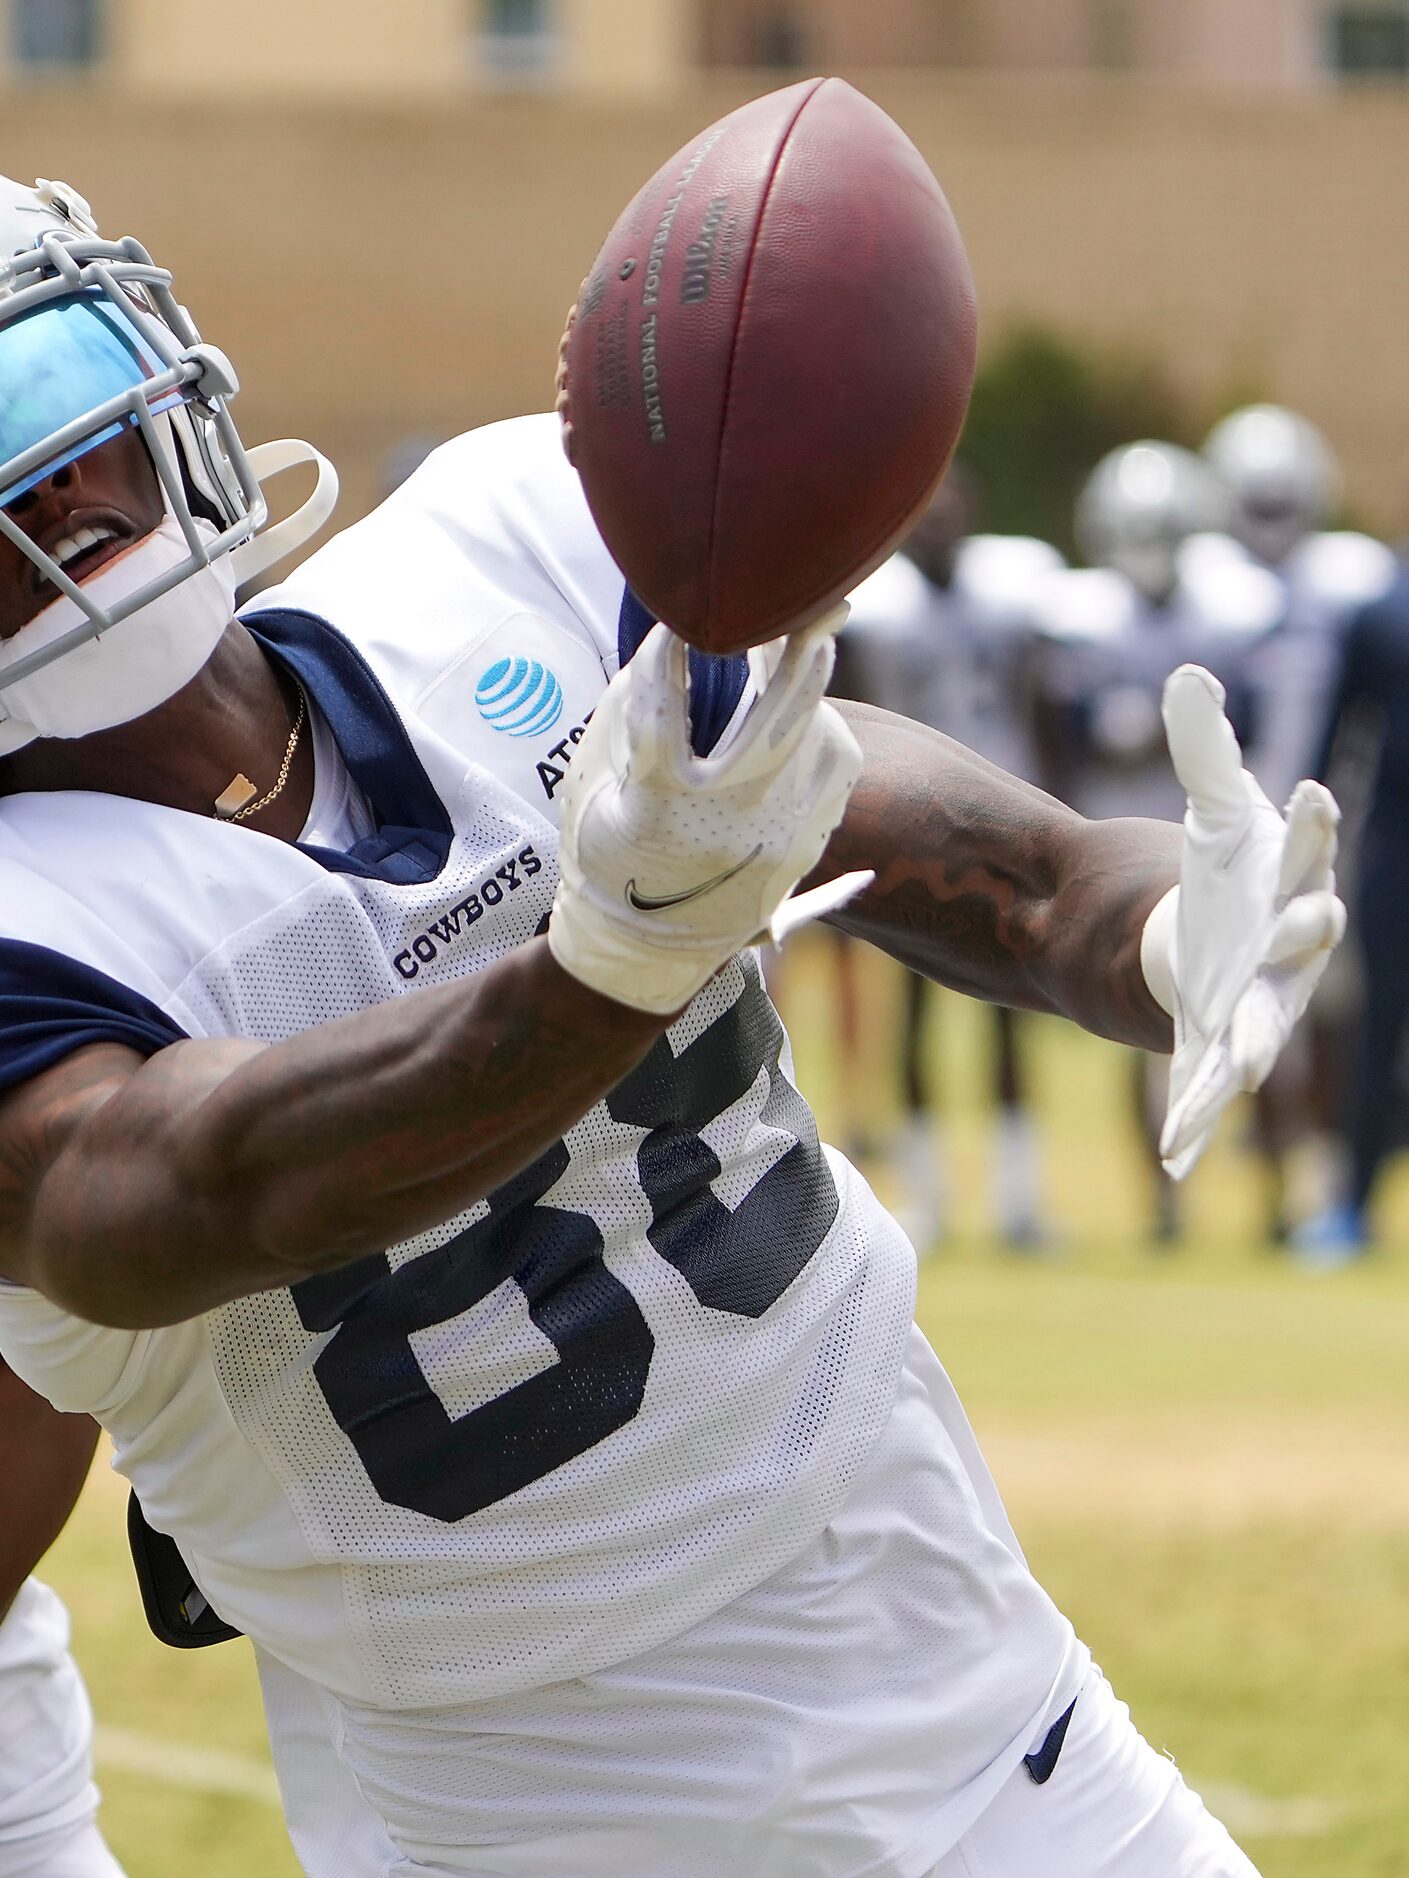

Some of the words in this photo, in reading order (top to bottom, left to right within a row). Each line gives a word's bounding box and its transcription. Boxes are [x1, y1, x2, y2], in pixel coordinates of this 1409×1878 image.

[643, 194, 682, 305] FOOTBALL
[682, 197, 728, 305] Wilson
[640, 312, 666, 442] NATIONAL
[393, 844, 542, 979] COWBOYS
[287, 910, 841, 1525] 88
